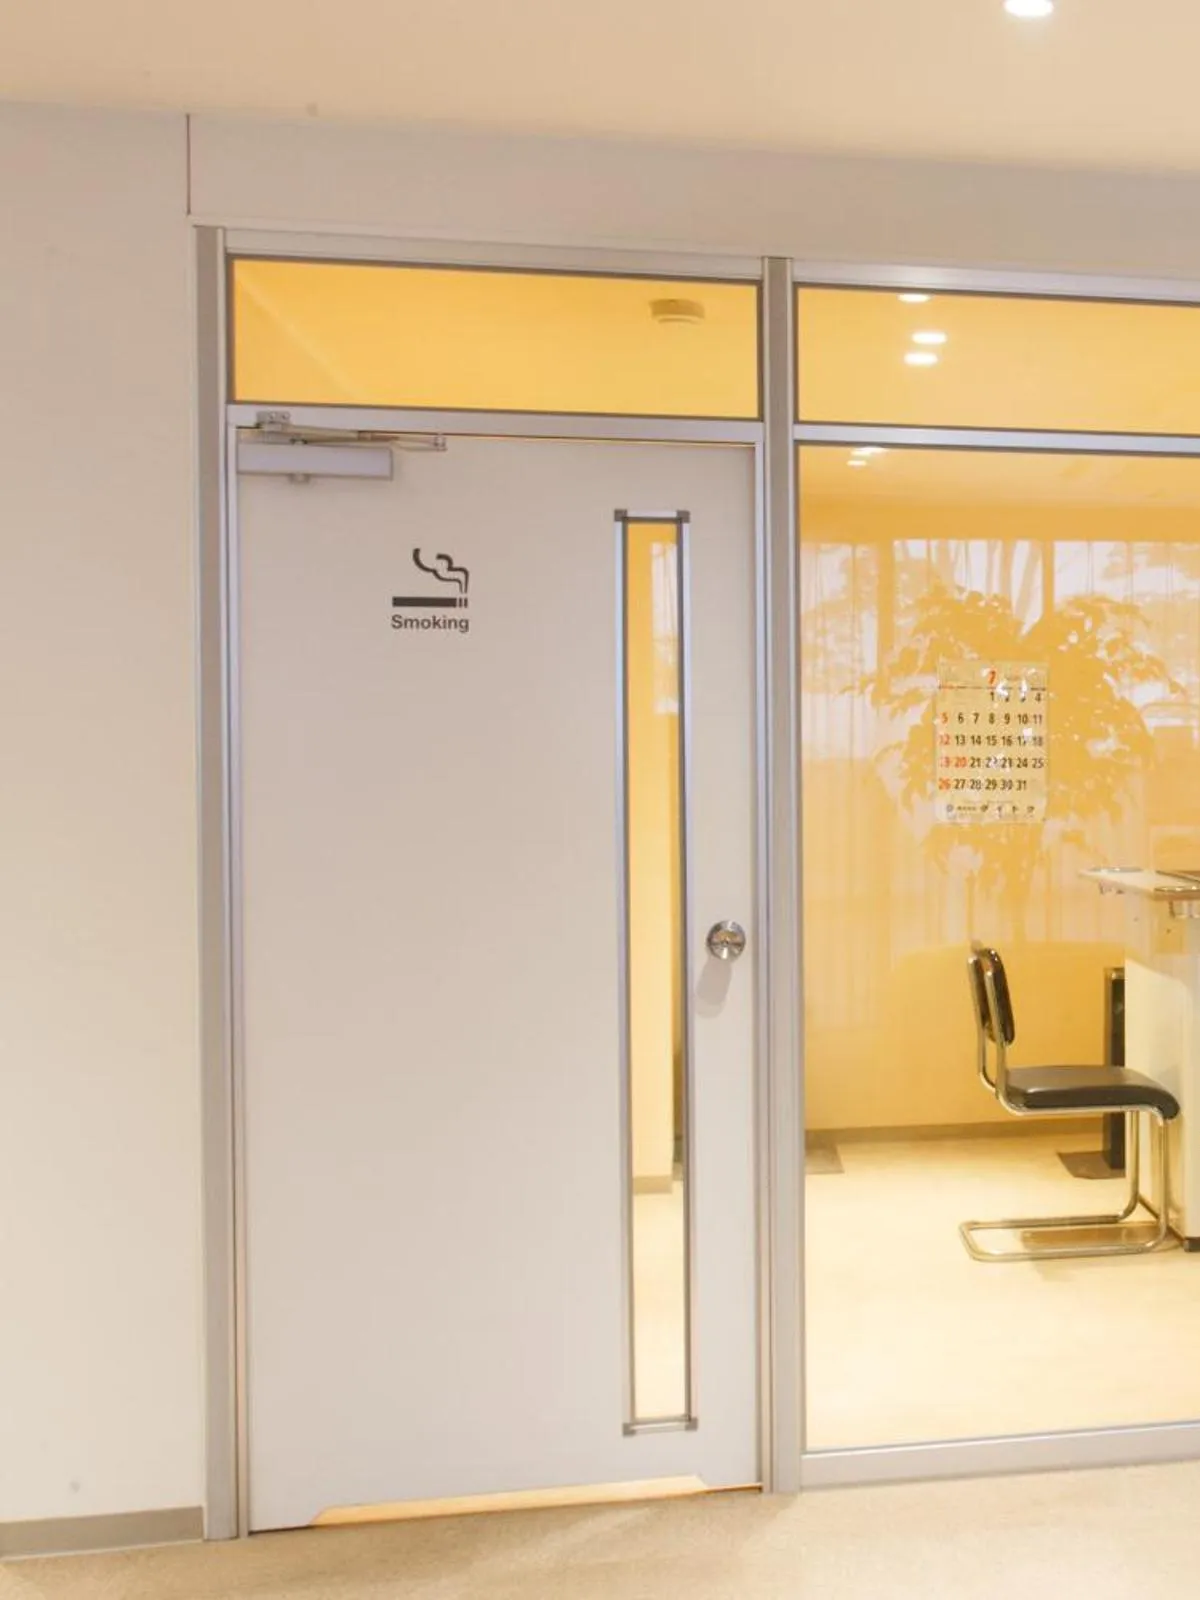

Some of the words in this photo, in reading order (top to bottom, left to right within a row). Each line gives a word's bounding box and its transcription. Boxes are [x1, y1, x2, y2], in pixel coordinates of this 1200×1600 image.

[392, 614, 469, 633] Smoking
[942, 713, 948, 723] 5
[958, 713, 964, 723] 6
[974, 713, 980, 723] 7
[989, 713, 995, 723] 8
[1004, 713, 1010, 724] 9
[1018, 714, 1028, 724] 10
[1033, 714, 1043, 724] 11
[939, 735, 950, 745] 12
[955, 735, 965, 745] 13
[970, 735, 981, 745] 14
[986, 735, 997, 745] 15
[1002, 735, 1012, 745] 16
[954, 757, 967, 767] 20
[970, 757, 981, 767] 21
[1017, 757, 1028, 767] 24
[1032, 757, 1043, 767] 25
[939, 779, 950, 789] 26
[954, 779, 965, 789] 27
[970, 779, 981, 789] 28
[985, 779, 997, 789] 29
[1001, 779, 1012, 790] 30
[1016, 780, 1027, 790] 31
